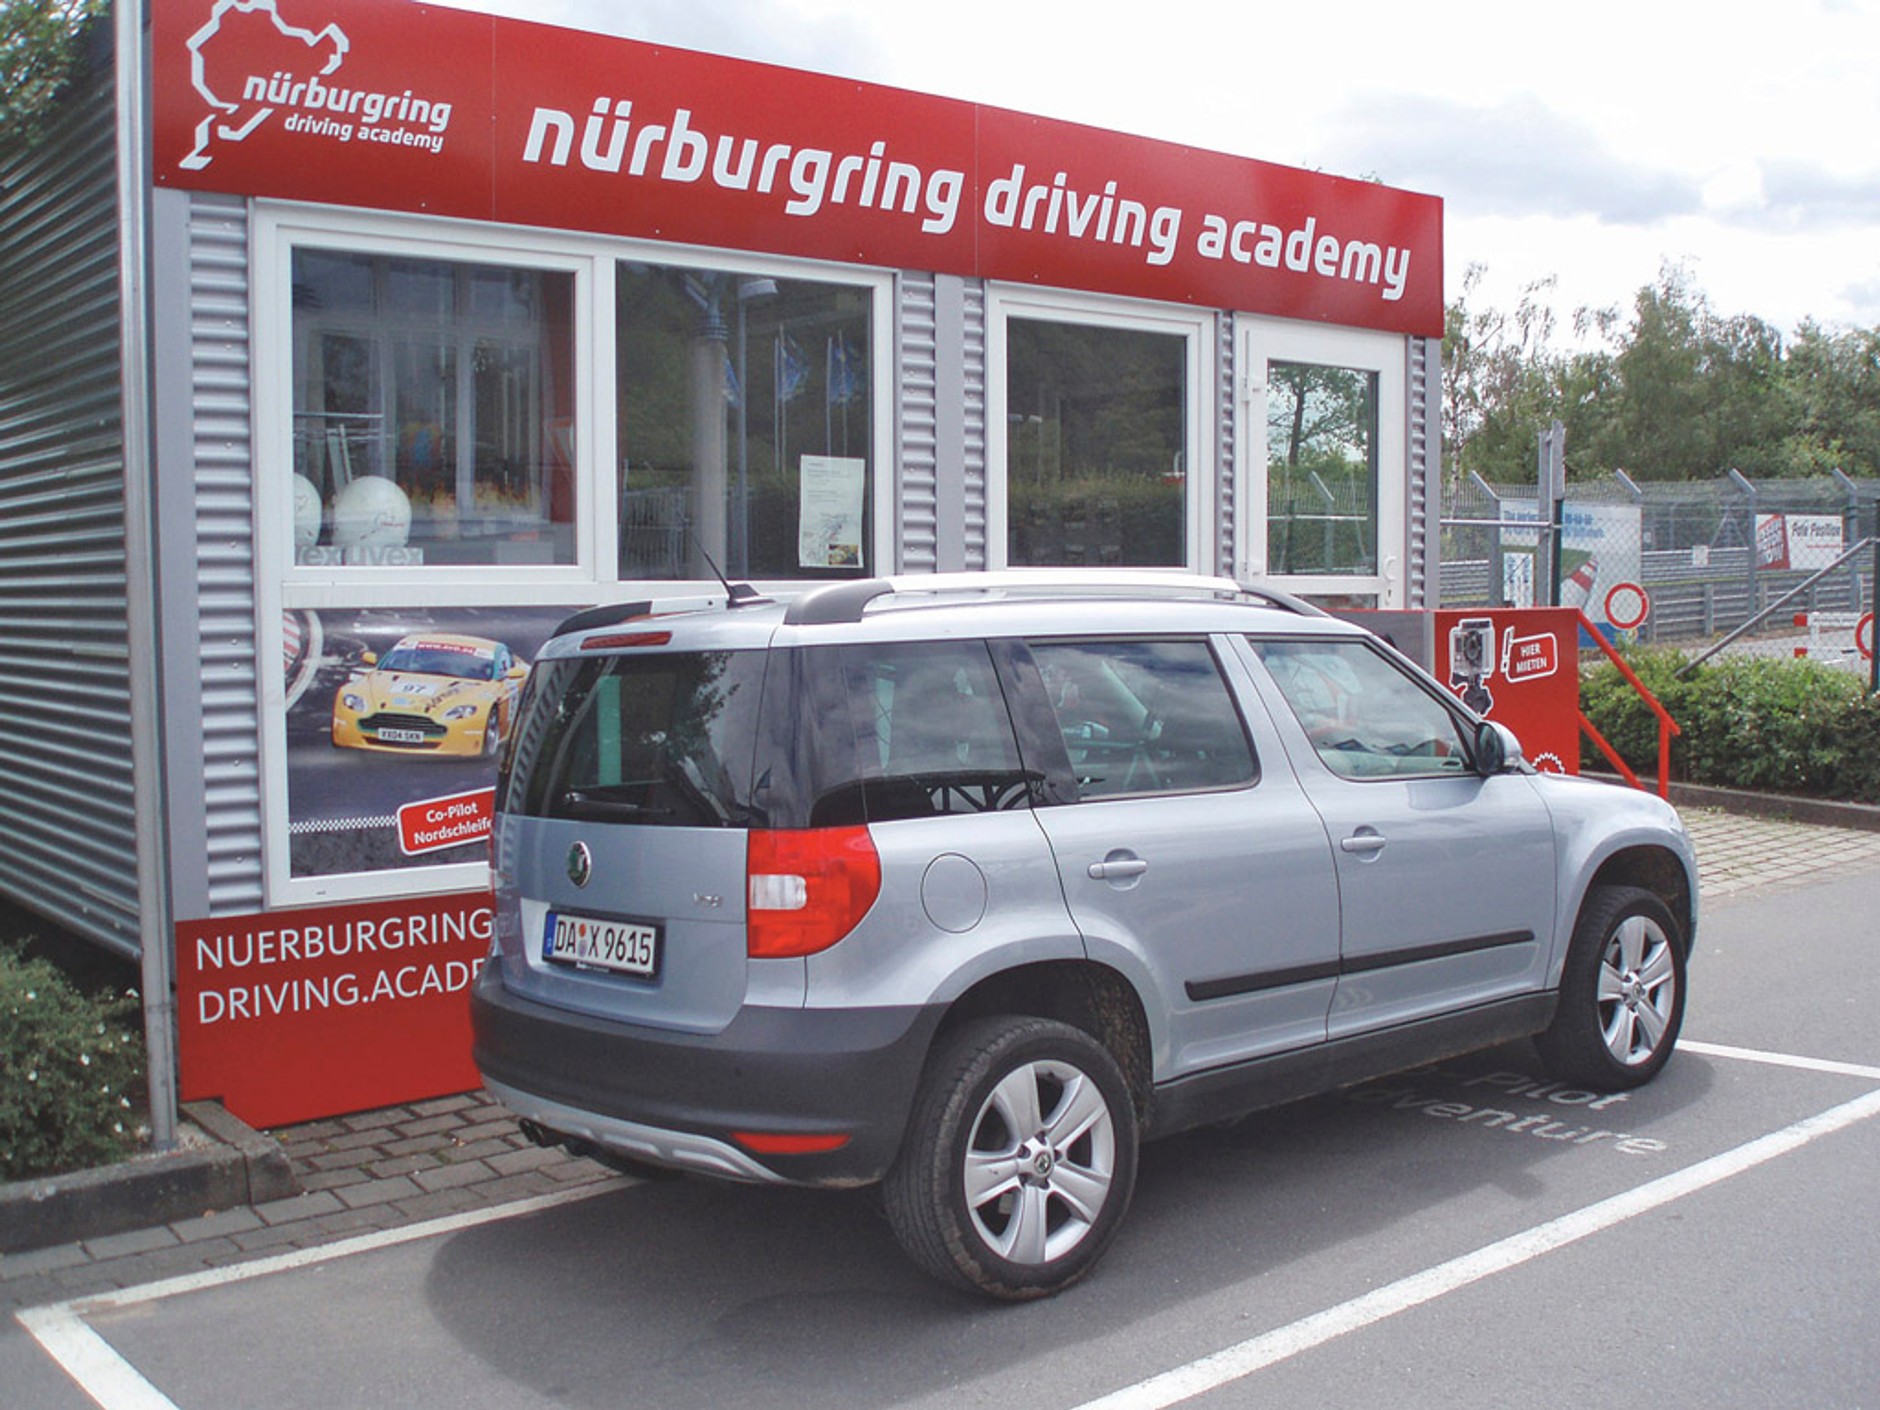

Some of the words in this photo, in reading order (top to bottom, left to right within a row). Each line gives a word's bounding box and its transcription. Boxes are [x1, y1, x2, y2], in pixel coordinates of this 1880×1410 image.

[242, 71, 453, 132] nürburgring
[284, 112, 354, 142] driving
[356, 126, 444, 154] academy
[522, 96, 965, 234] nürburgring
[983, 163, 1183, 266] driving
[1197, 213, 1411, 301] academy
[345, 546, 422, 565] uvex
[1516, 656, 1548, 673] MIETEN
[1520, 642, 1541, 658] HIER
[425, 802, 479, 823] Co-Pilot
[196, 908, 494, 971] NUERBURGRING
[554, 920, 577, 955] DA
[588, 924, 601, 958] X
[604, 927, 652, 966] 9615
